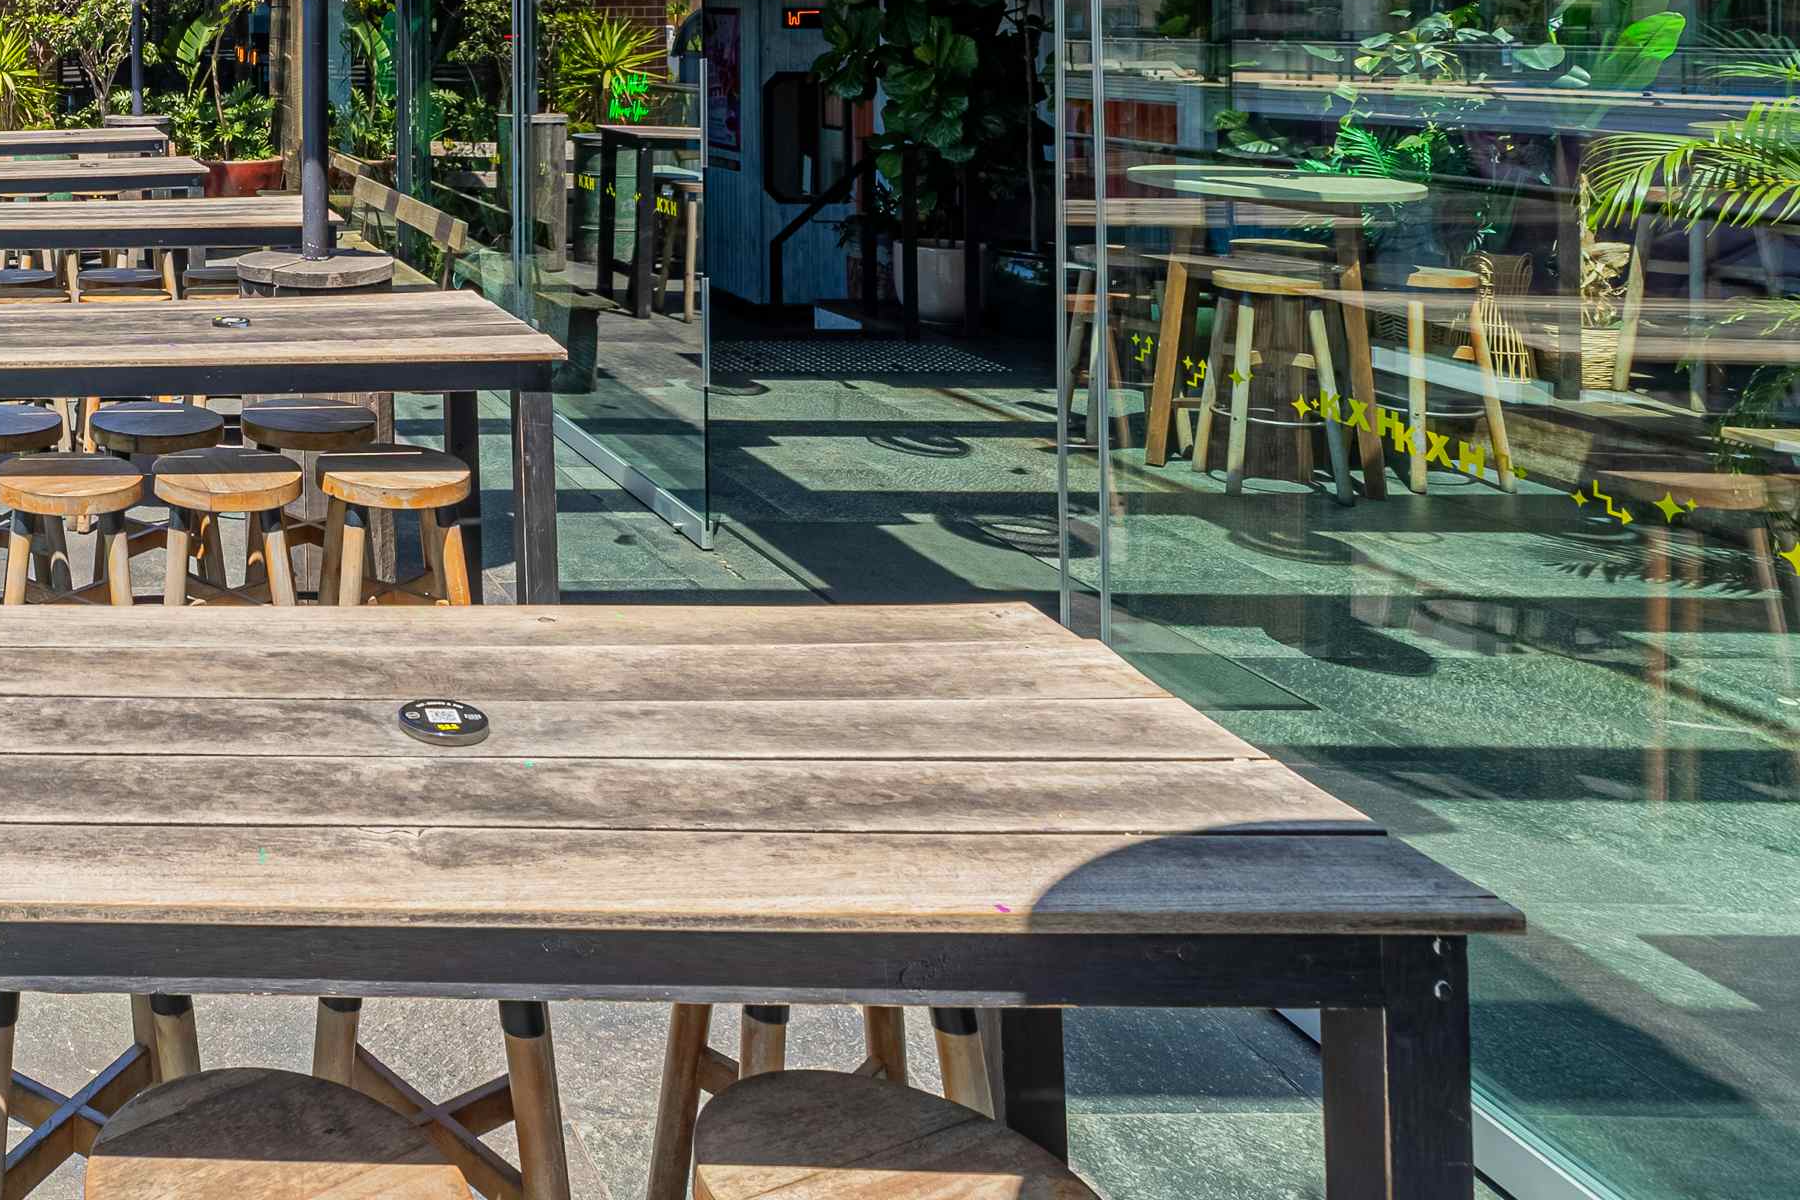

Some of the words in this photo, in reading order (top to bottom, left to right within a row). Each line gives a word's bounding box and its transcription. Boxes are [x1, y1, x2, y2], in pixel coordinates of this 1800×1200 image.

[578, 174, 595, 192] KXH
[656, 196, 677, 217] KXH
[1320, 388, 1400, 440] KXH
[1394, 421, 1486, 479] KXH
